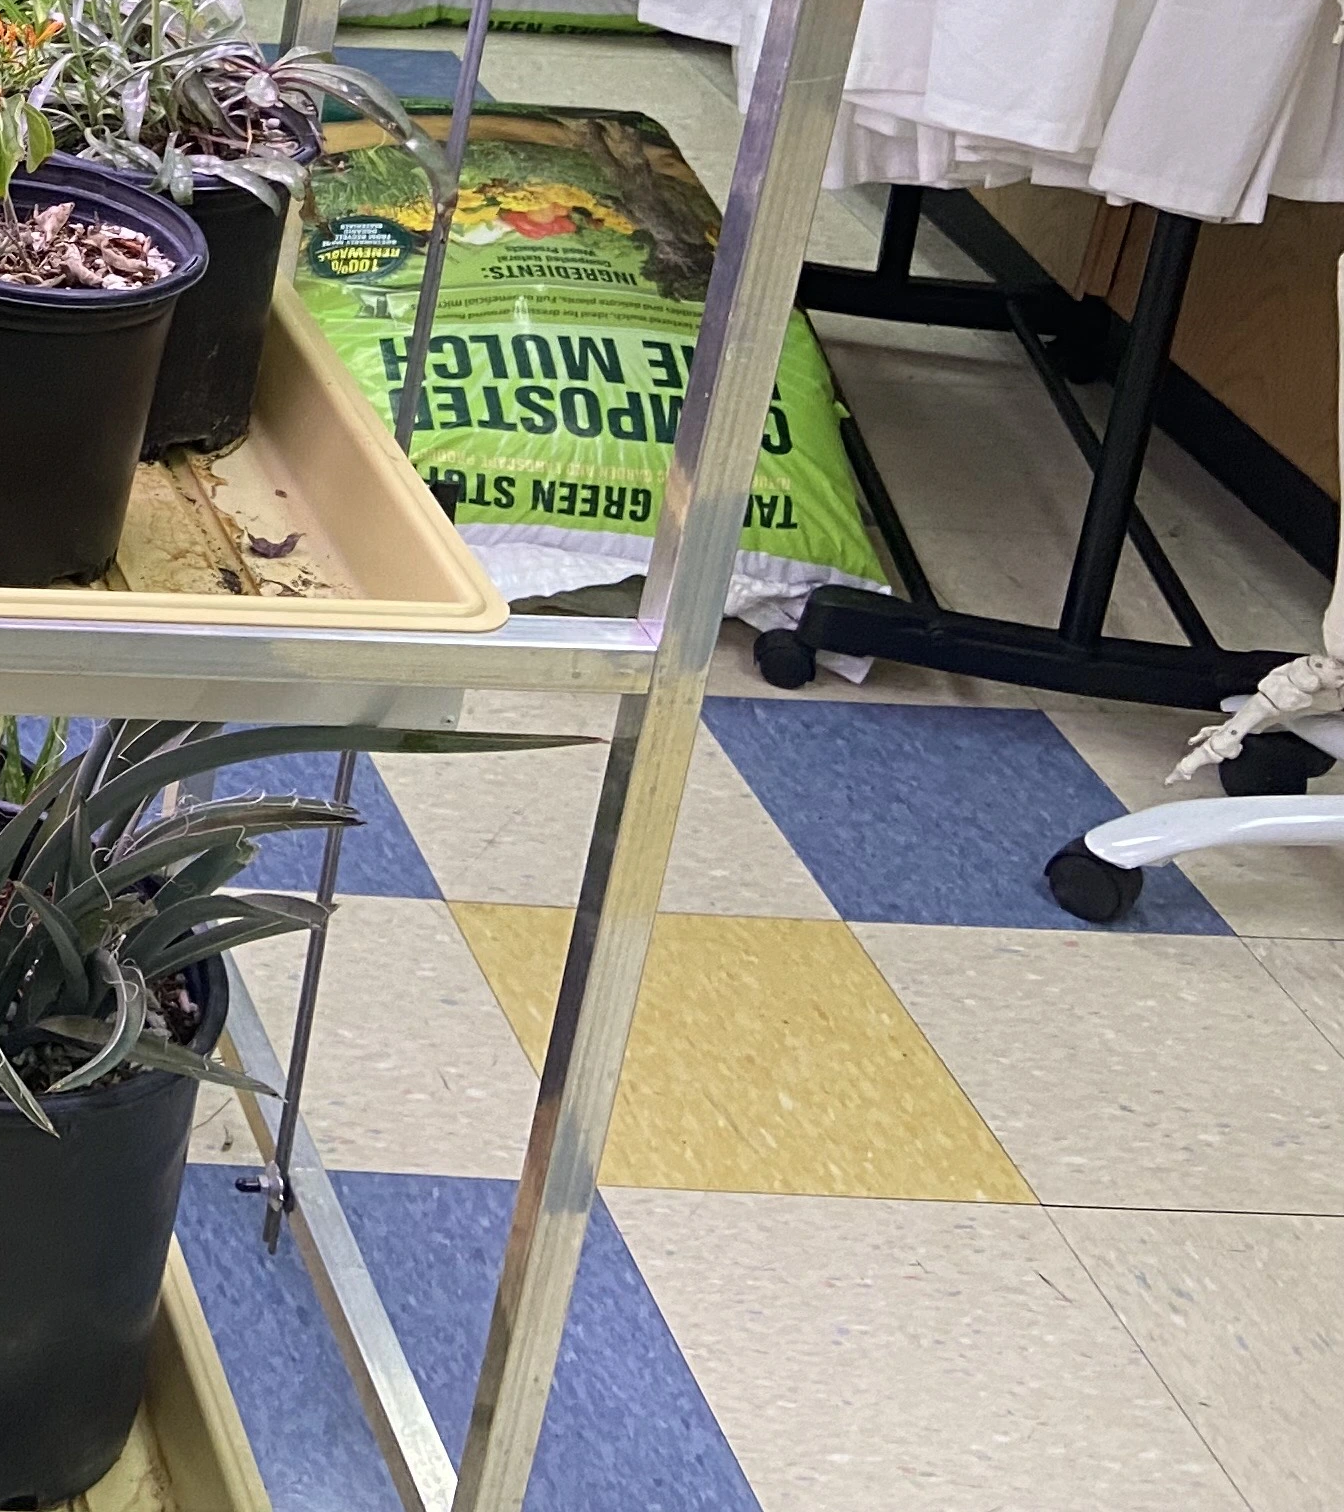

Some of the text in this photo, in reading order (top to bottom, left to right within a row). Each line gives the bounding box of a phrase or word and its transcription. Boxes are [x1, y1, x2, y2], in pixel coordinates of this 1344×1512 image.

[317, 248, 400, 263] RENEWABLE
[331, 259, 379, 275] 100%
[480, 265, 638, 286] INGREDIENTS:
[378, 333, 626, 385] MULCH
[531, 478, 653, 523] GREEN
